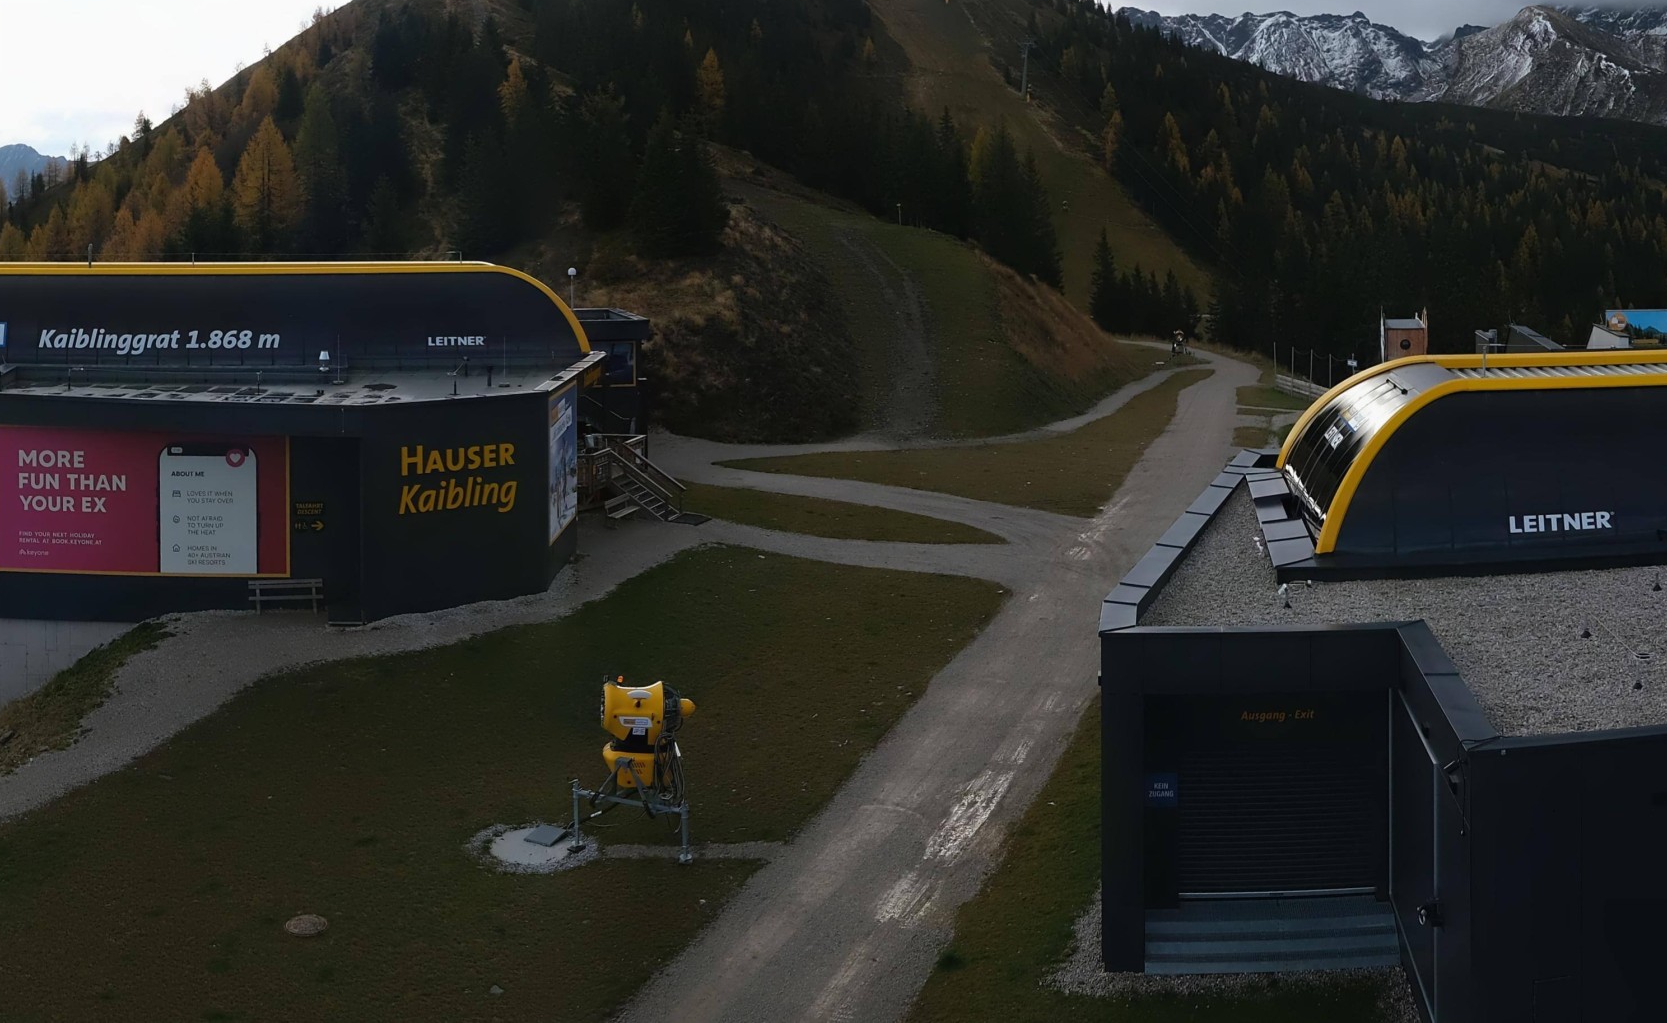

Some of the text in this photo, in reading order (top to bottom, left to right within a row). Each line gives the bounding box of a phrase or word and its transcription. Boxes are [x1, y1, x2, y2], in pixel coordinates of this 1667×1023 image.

[38, 328, 281, 355] Kaiblinggrat 1.868 m
[427, 335, 485, 347] LEITNER
[18, 449, 85, 468] MORE
[400, 443, 516, 476] HAUSER
[18, 472, 127, 491] FUN THAN
[19, 495, 107, 513] YOUR EX
[398, 476, 518, 515] Kaibling
[1508, 511, 1613, 533] LEITNER
[26, 549, 49, 557] keyone
[1240, 710, 1286, 723] Ausgang
[1294, 709, 1315, 719] Exit
[1148, 790, 1174, 798] ZUGANG
